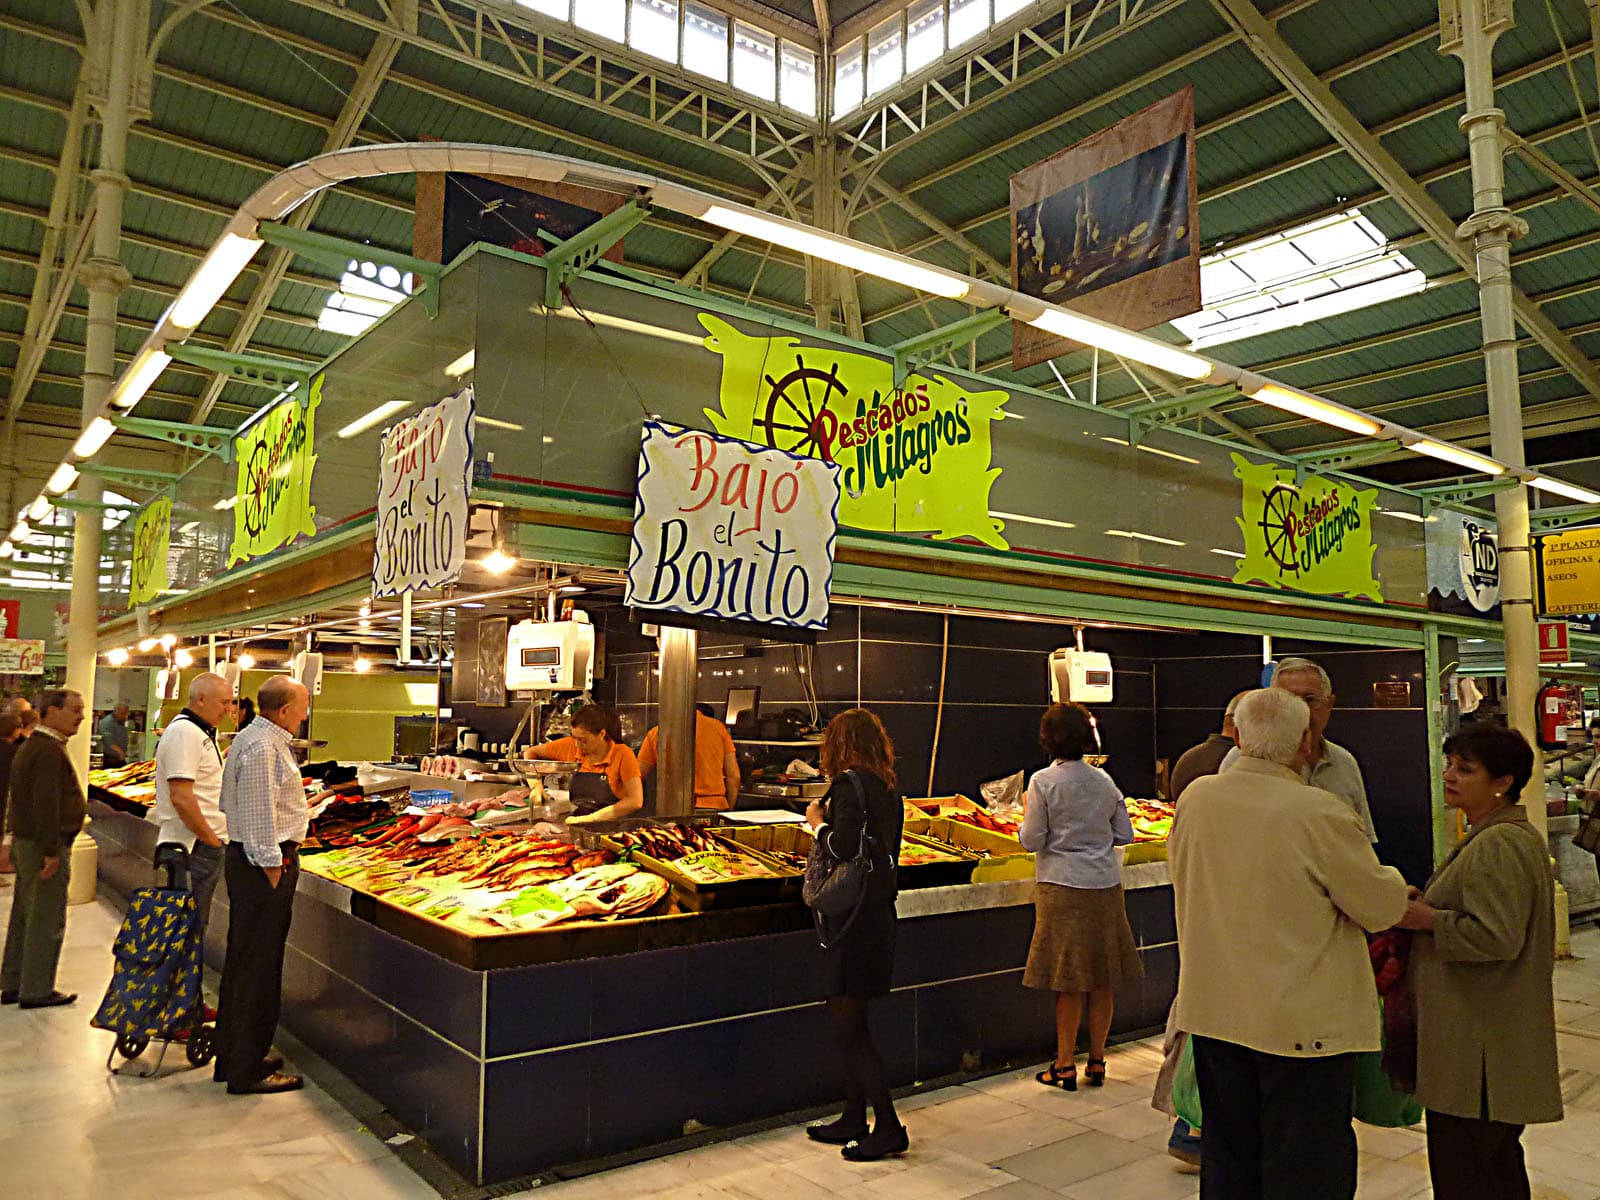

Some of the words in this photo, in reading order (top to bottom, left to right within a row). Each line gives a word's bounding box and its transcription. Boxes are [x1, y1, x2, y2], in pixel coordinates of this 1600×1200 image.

[812, 384, 931, 462] Pescados
[844, 390, 971, 499] Milagros
[400, 479, 414, 519] el
[675, 434, 805, 537] Bajó
[380, 478, 453, 586] Bonito
[713, 511, 736, 547] el
[1284, 487, 1340, 553] Pescados
[1301, 496, 1361, 573] Milagros
[1560, 539, 1600, 550] PLANTA
[630, 519, 810, 619] Bonito
[1545, 555, 1593, 566] OFICINAS
[1547, 573, 1578, 582] ASEOS
[1547, 602, 1600, 613] CAFETERI
